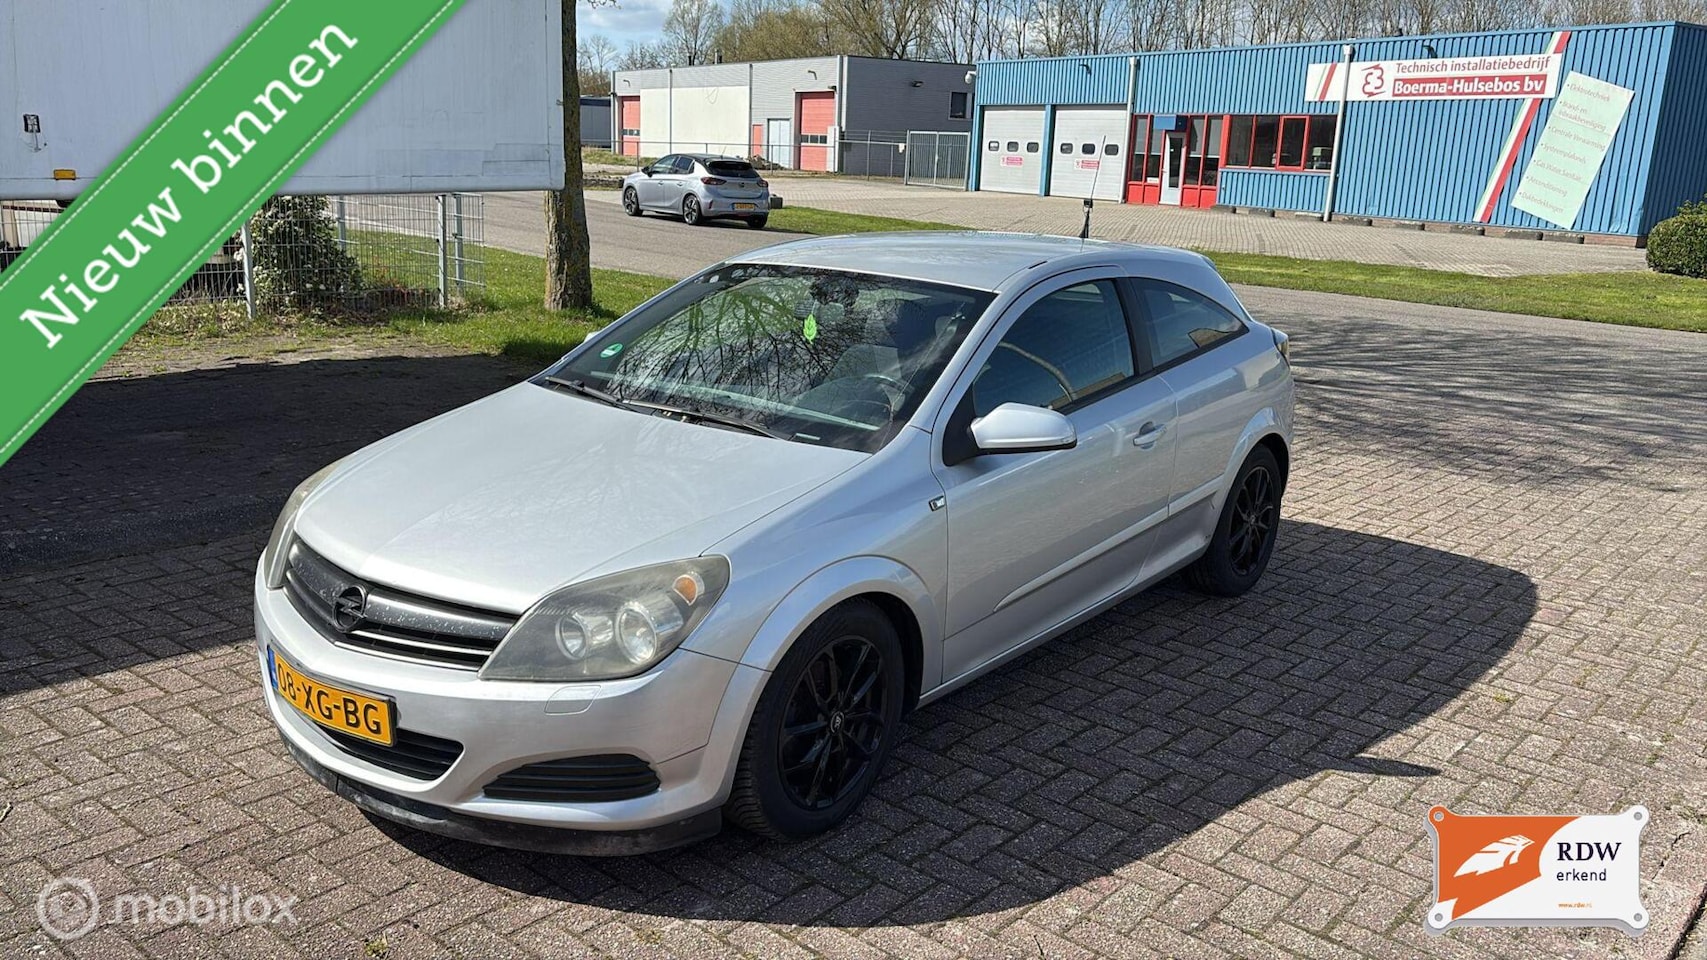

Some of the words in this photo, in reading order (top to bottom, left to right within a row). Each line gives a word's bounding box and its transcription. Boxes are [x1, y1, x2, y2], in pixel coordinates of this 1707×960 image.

[1395, 61, 1448, 75] Technisch
[1450, 56, 1551, 72] installatiebedrijf
[1394, 77, 1520, 95] Boerma-Hulsebos
[1523, 75, 1545, 91] bv
[277, 663, 382, 735] 08-XG-BG
